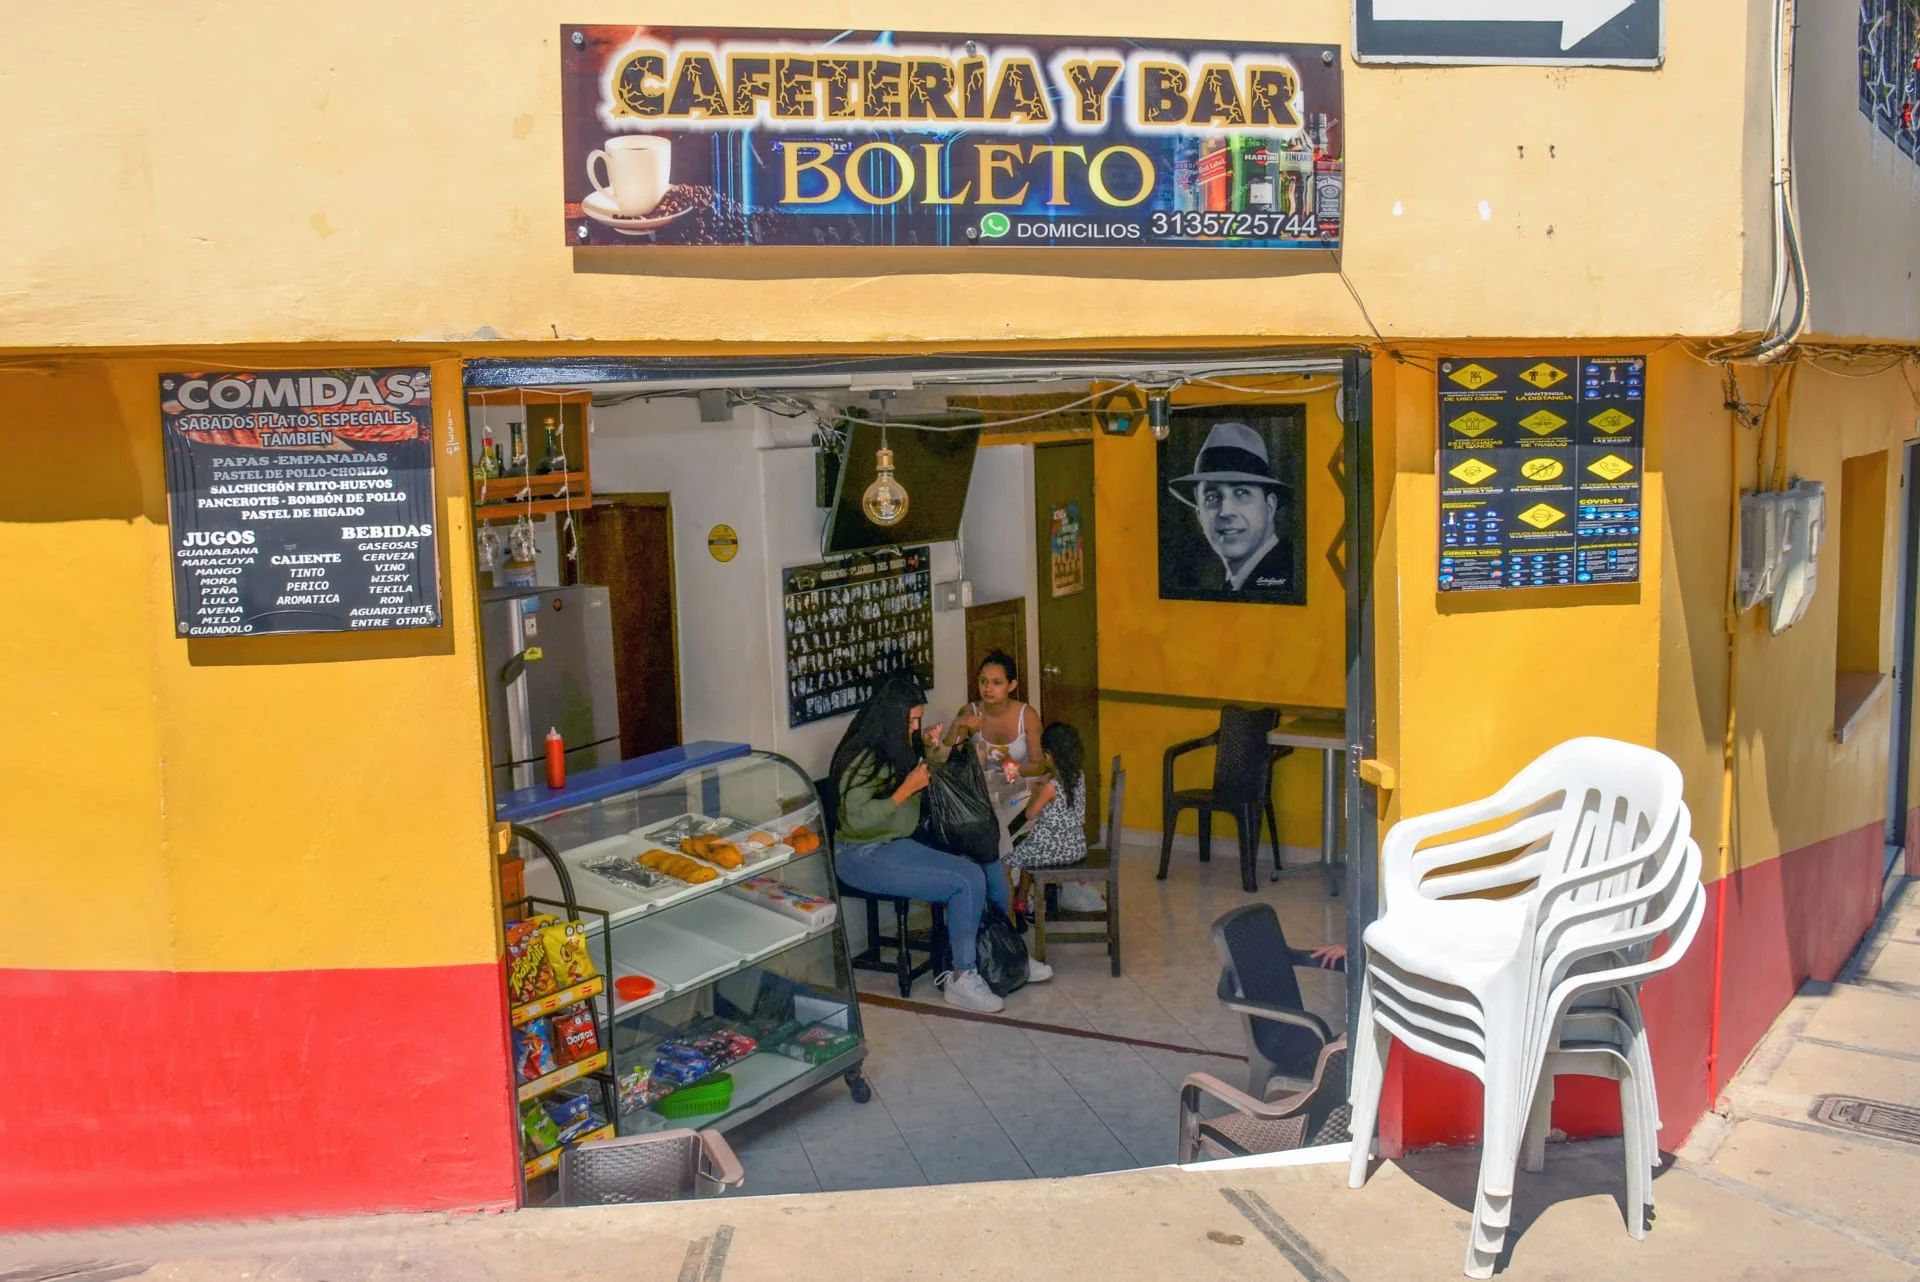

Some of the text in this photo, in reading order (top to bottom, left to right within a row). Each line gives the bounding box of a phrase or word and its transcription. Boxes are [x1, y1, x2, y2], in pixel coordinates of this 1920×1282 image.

[1063, 60, 1124, 124] Y
[1139, 60, 1301, 128] BAR
[779, 142, 1156, 207] BOLETO
[1017, 211, 1318, 239] DOMICILIOS 3135725744
[178, 374, 416, 409] COMIDAS
[179, 411, 411, 431] SABADOS PLATOS ESPECIALES
[261, 431, 332, 447] TAMBIEN
[212, 456, 270, 467] PAPAS
[213, 466, 388, 481] PASTEL DE POLLO-CHORIZO
[210, 479, 393, 495] SALCHICHÓN FRITO-HUEVOS
[197, 496, 280, 508] PANCEROTIS
[287, 492, 343, 505] BOMBÓN
[346, 493, 364, 503] DE
[366, 492, 407, 502] POLLO
[241, 507, 365, 520] PASTEL DE HIGADO
[341, 524, 433, 539] BEBIDAS
[182, 530, 256, 546] JUGOS
[358, 541, 419, 551] GASEOSAS
[177, 547, 259, 557] GUANABANA
[362, 552, 415, 562] CERVEZA
[181, 557, 255, 567] MARACUYA
[271, 553, 342, 565] CALIENTE
[195, 567, 242, 576] MANGO
[290, 567, 325, 578] TINTO
[374, 563, 405, 572] VINO
[200, 577, 237, 586] MORA
[370, 574, 410, 583] WISKY
[201, 586, 238, 595] PIÑA
[286, 581, 330, 591] PERICO
[368, 585, 413, 594] TEKILA
[202, 596, 239, 605] LULO
[276, 594, 340, 605] AROMATICA
[380, 596, 404, 605] RON
[197, 606, 244, 615] AVENA
[349, 605, 432, 617] AGUARDIENTE
[201, 616, 241, 625] MILO
[351, 618, 390, 628] ENTRE
[190, 624, 253, 635] GUANDOLO
[566, 1029, 594, 1046] Doritos
